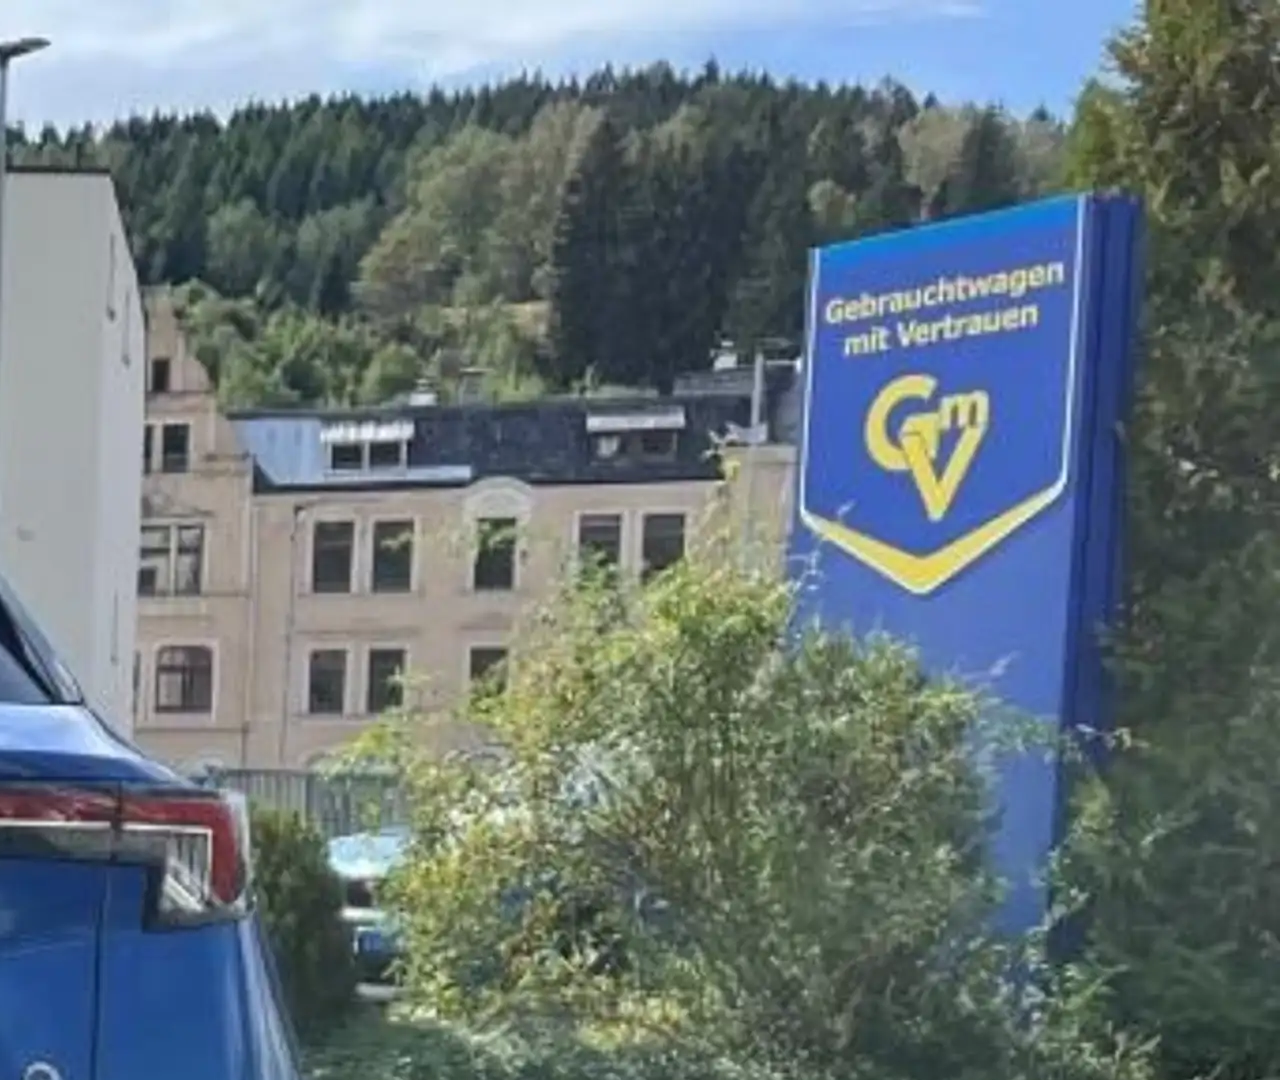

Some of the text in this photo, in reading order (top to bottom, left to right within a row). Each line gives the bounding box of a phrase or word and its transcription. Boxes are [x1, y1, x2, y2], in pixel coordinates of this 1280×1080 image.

[825, 260, 1065, 325] Gebrauchtwagen
[843, 303, 1040, 357] mit Vertrauen
